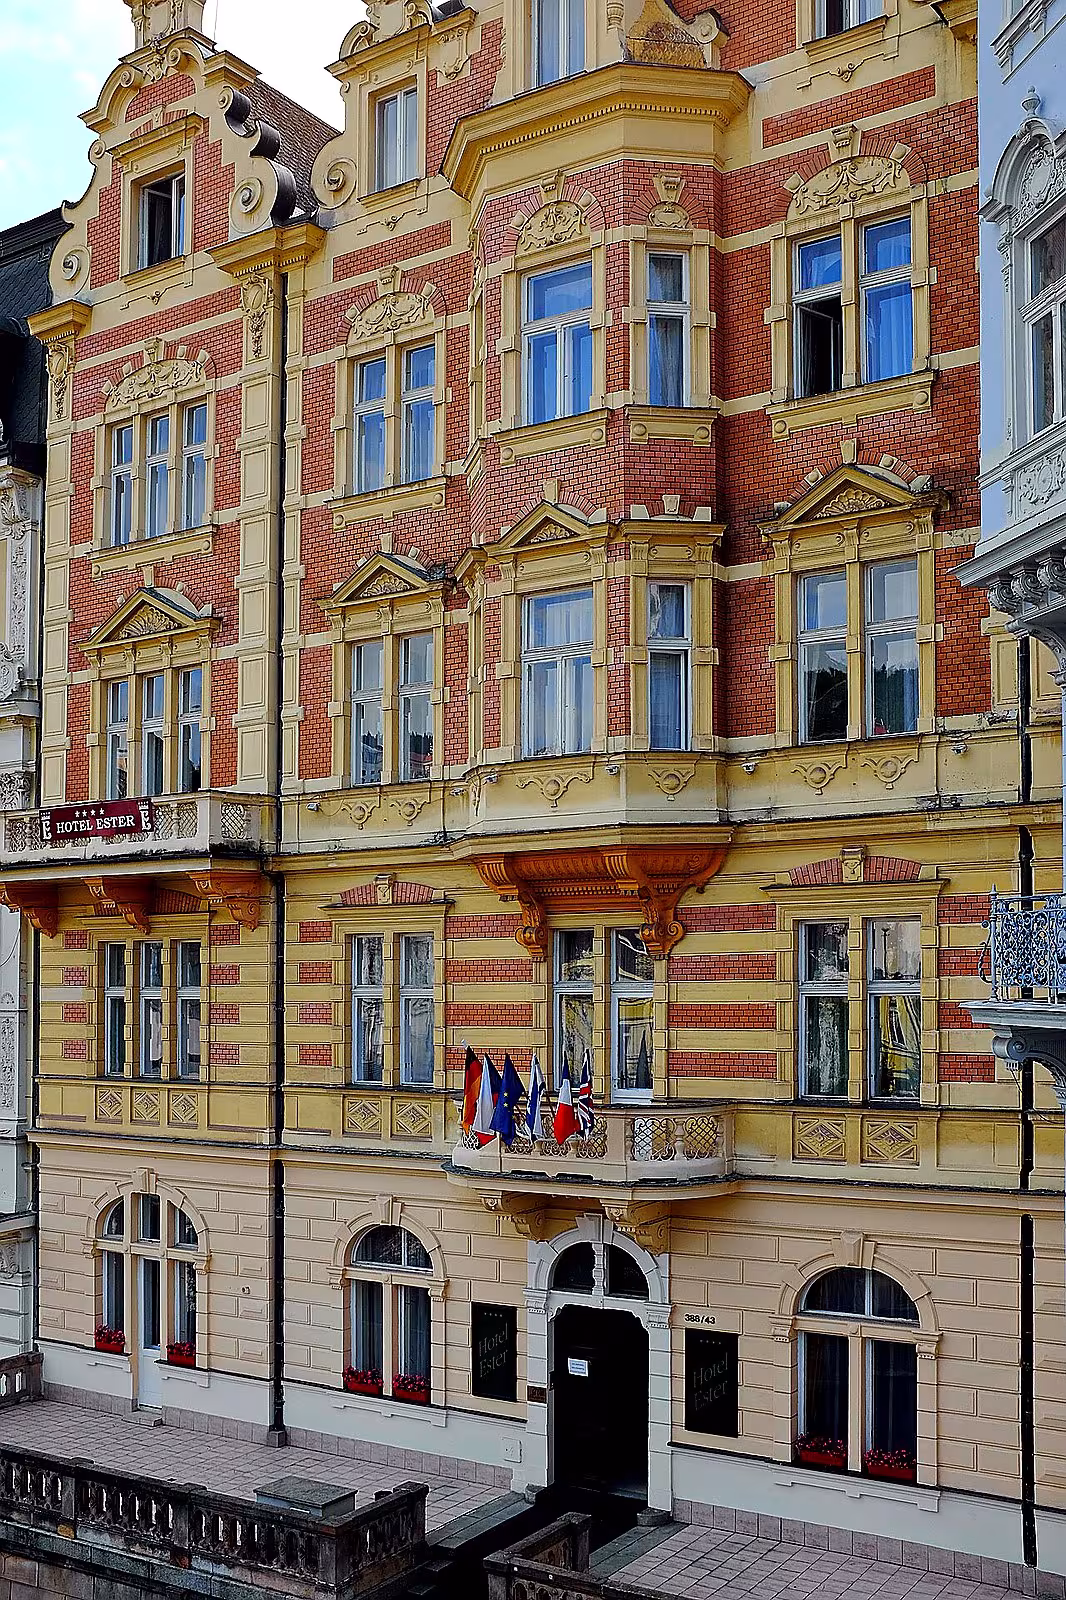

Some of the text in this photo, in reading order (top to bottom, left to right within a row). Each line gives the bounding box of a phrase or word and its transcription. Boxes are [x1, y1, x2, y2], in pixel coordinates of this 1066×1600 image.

[56, 815, 135, 833] HOTEL ESTER
[685, 1313, 716, 1325] 388/43
[479, 1321, 508, 1357] Hotel
[480, 1349, 508, 1378] Ester
[693, 1351, 728, 1389] Hotel
[694, 1380, 729, 1411] Ester
